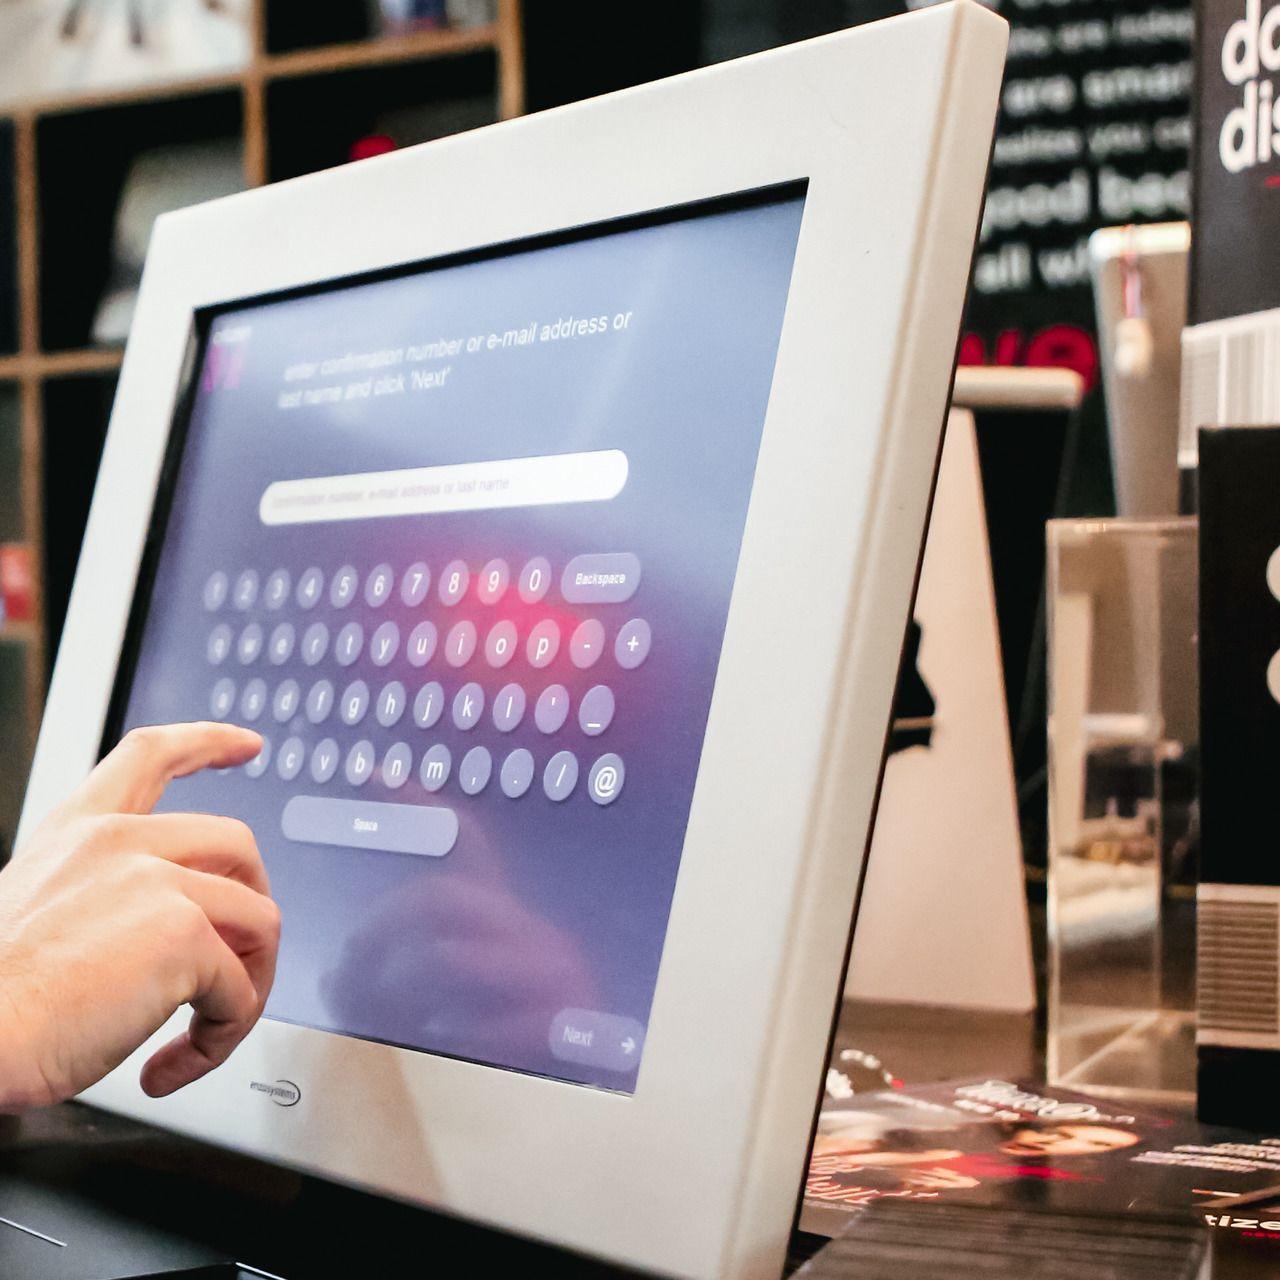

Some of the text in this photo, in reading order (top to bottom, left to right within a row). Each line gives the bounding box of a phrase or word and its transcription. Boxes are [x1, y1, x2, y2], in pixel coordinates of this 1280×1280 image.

[1219, 78, 1280, 174] di
[406, 338, 462, 363] number
[466, 334, 484, 353] or
[486, 321, 537, 350] e-mail
[540, 313, 609, 343] address
[612, 310, 634, 332] or
[344, 380, 372, 401] and
[373, 372, 407, 396] click
[411, 366, 452, 391] 'Next'
[304, 576, 316, 597] 4
[338, 575, 351, 597] 5
[374, 574, 385, 597] 6
[411, 573, 423, 596] 7
[448, 572, 460, 594] 8
[487, 570, 500, 593] 9
[575, 572, 627, 588] Backspace
[378, 637, 391, 660] y
[416, 637, 428, 655] u
[495, 637, 507, 655] o
[535, 637, 549, 661] p
[281, 689, 293, 711] d
[348, 696, 361, 720] g
[385, 692, 396, 715] h
[422, 693, 434, 721] j
[462, 694, 473, 718] k
[355, 751, 366, 773] b
[391, 758, 402, 776] n
[426, 761, 444, 779] m
[594, 766, 617, 798] @
[352, 817, 379, 832] Space
[563, 1024, 594, 1048] Next
